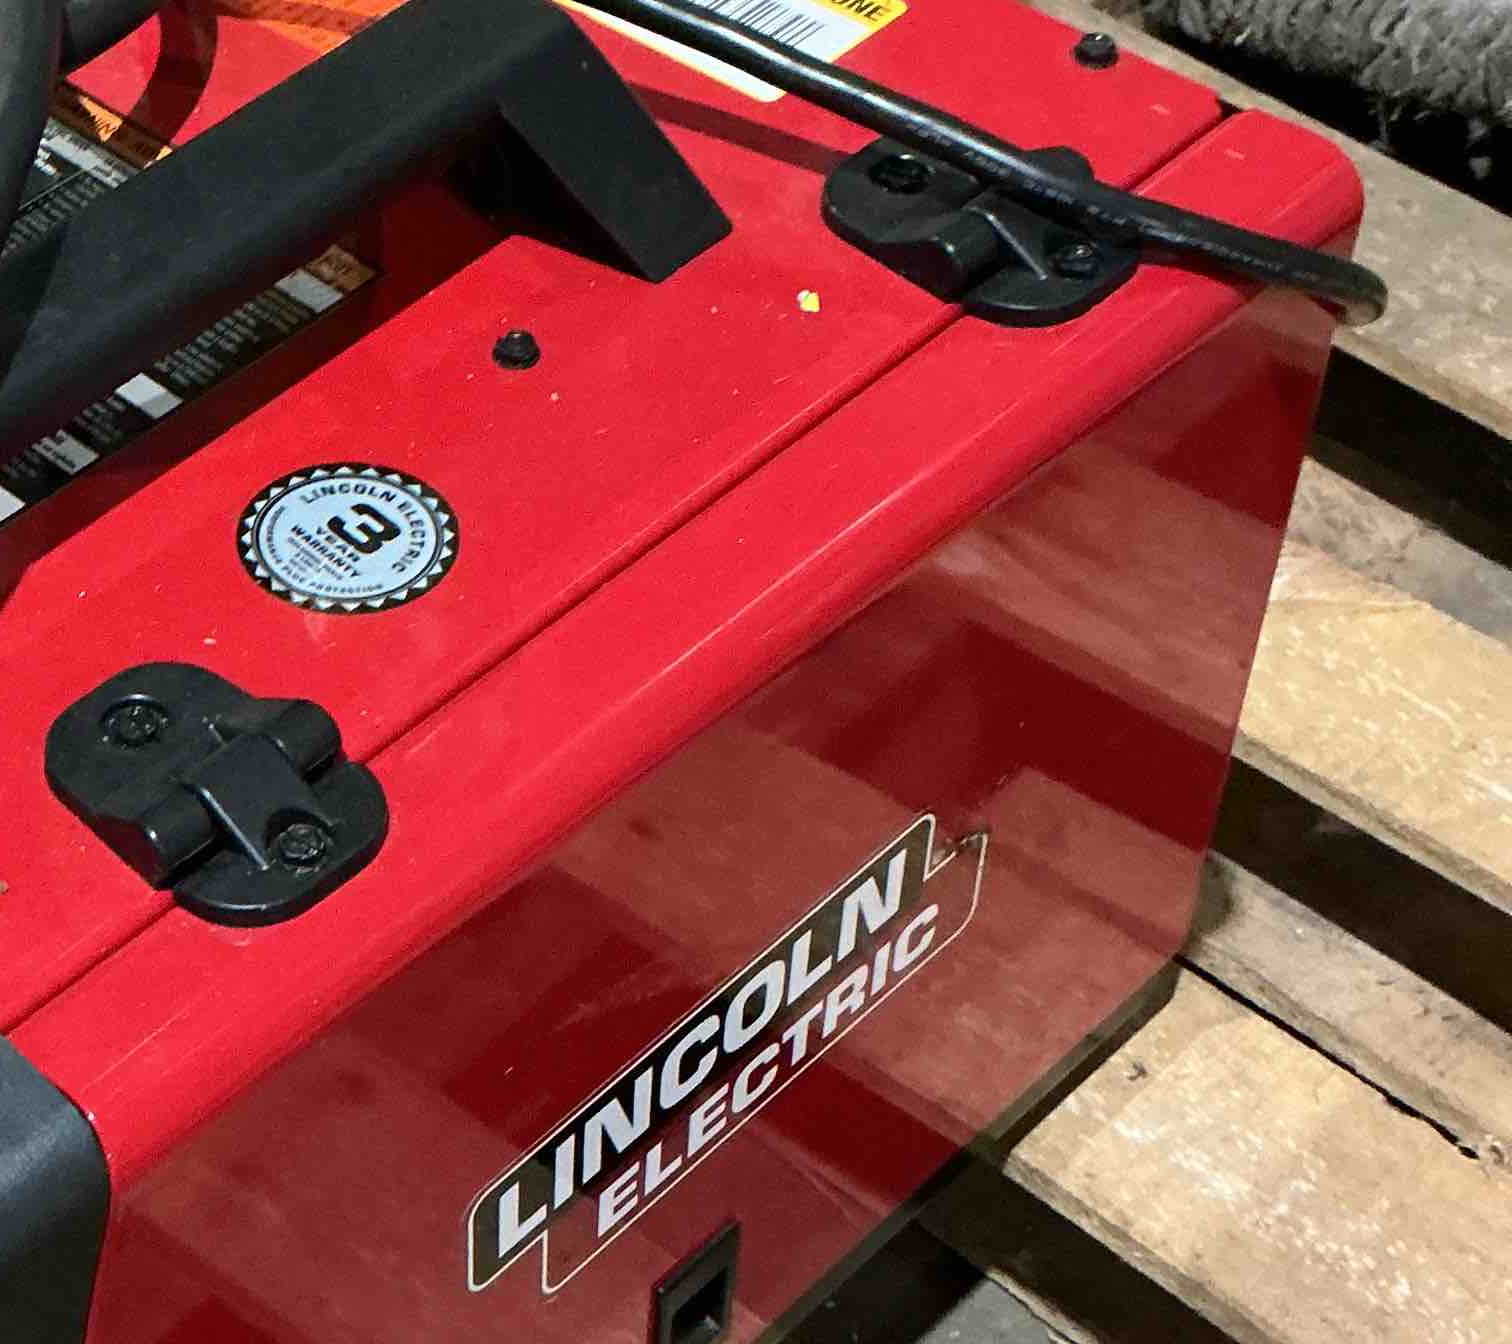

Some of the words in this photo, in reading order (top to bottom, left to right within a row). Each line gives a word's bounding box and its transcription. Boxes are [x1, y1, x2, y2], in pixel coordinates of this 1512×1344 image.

[290, 524, 367, 580] WARRANTY
[300, 482, 397, 504] LINCOLN
[391, 500, 428, 574] ELECTRIC
[314, 526, 361, 564] YEAR
[327, 503, 402, 555] 3
[498, 848, 908, 1258] LINCOLN
[597, 902, 939, 1239] ELECTRIC
